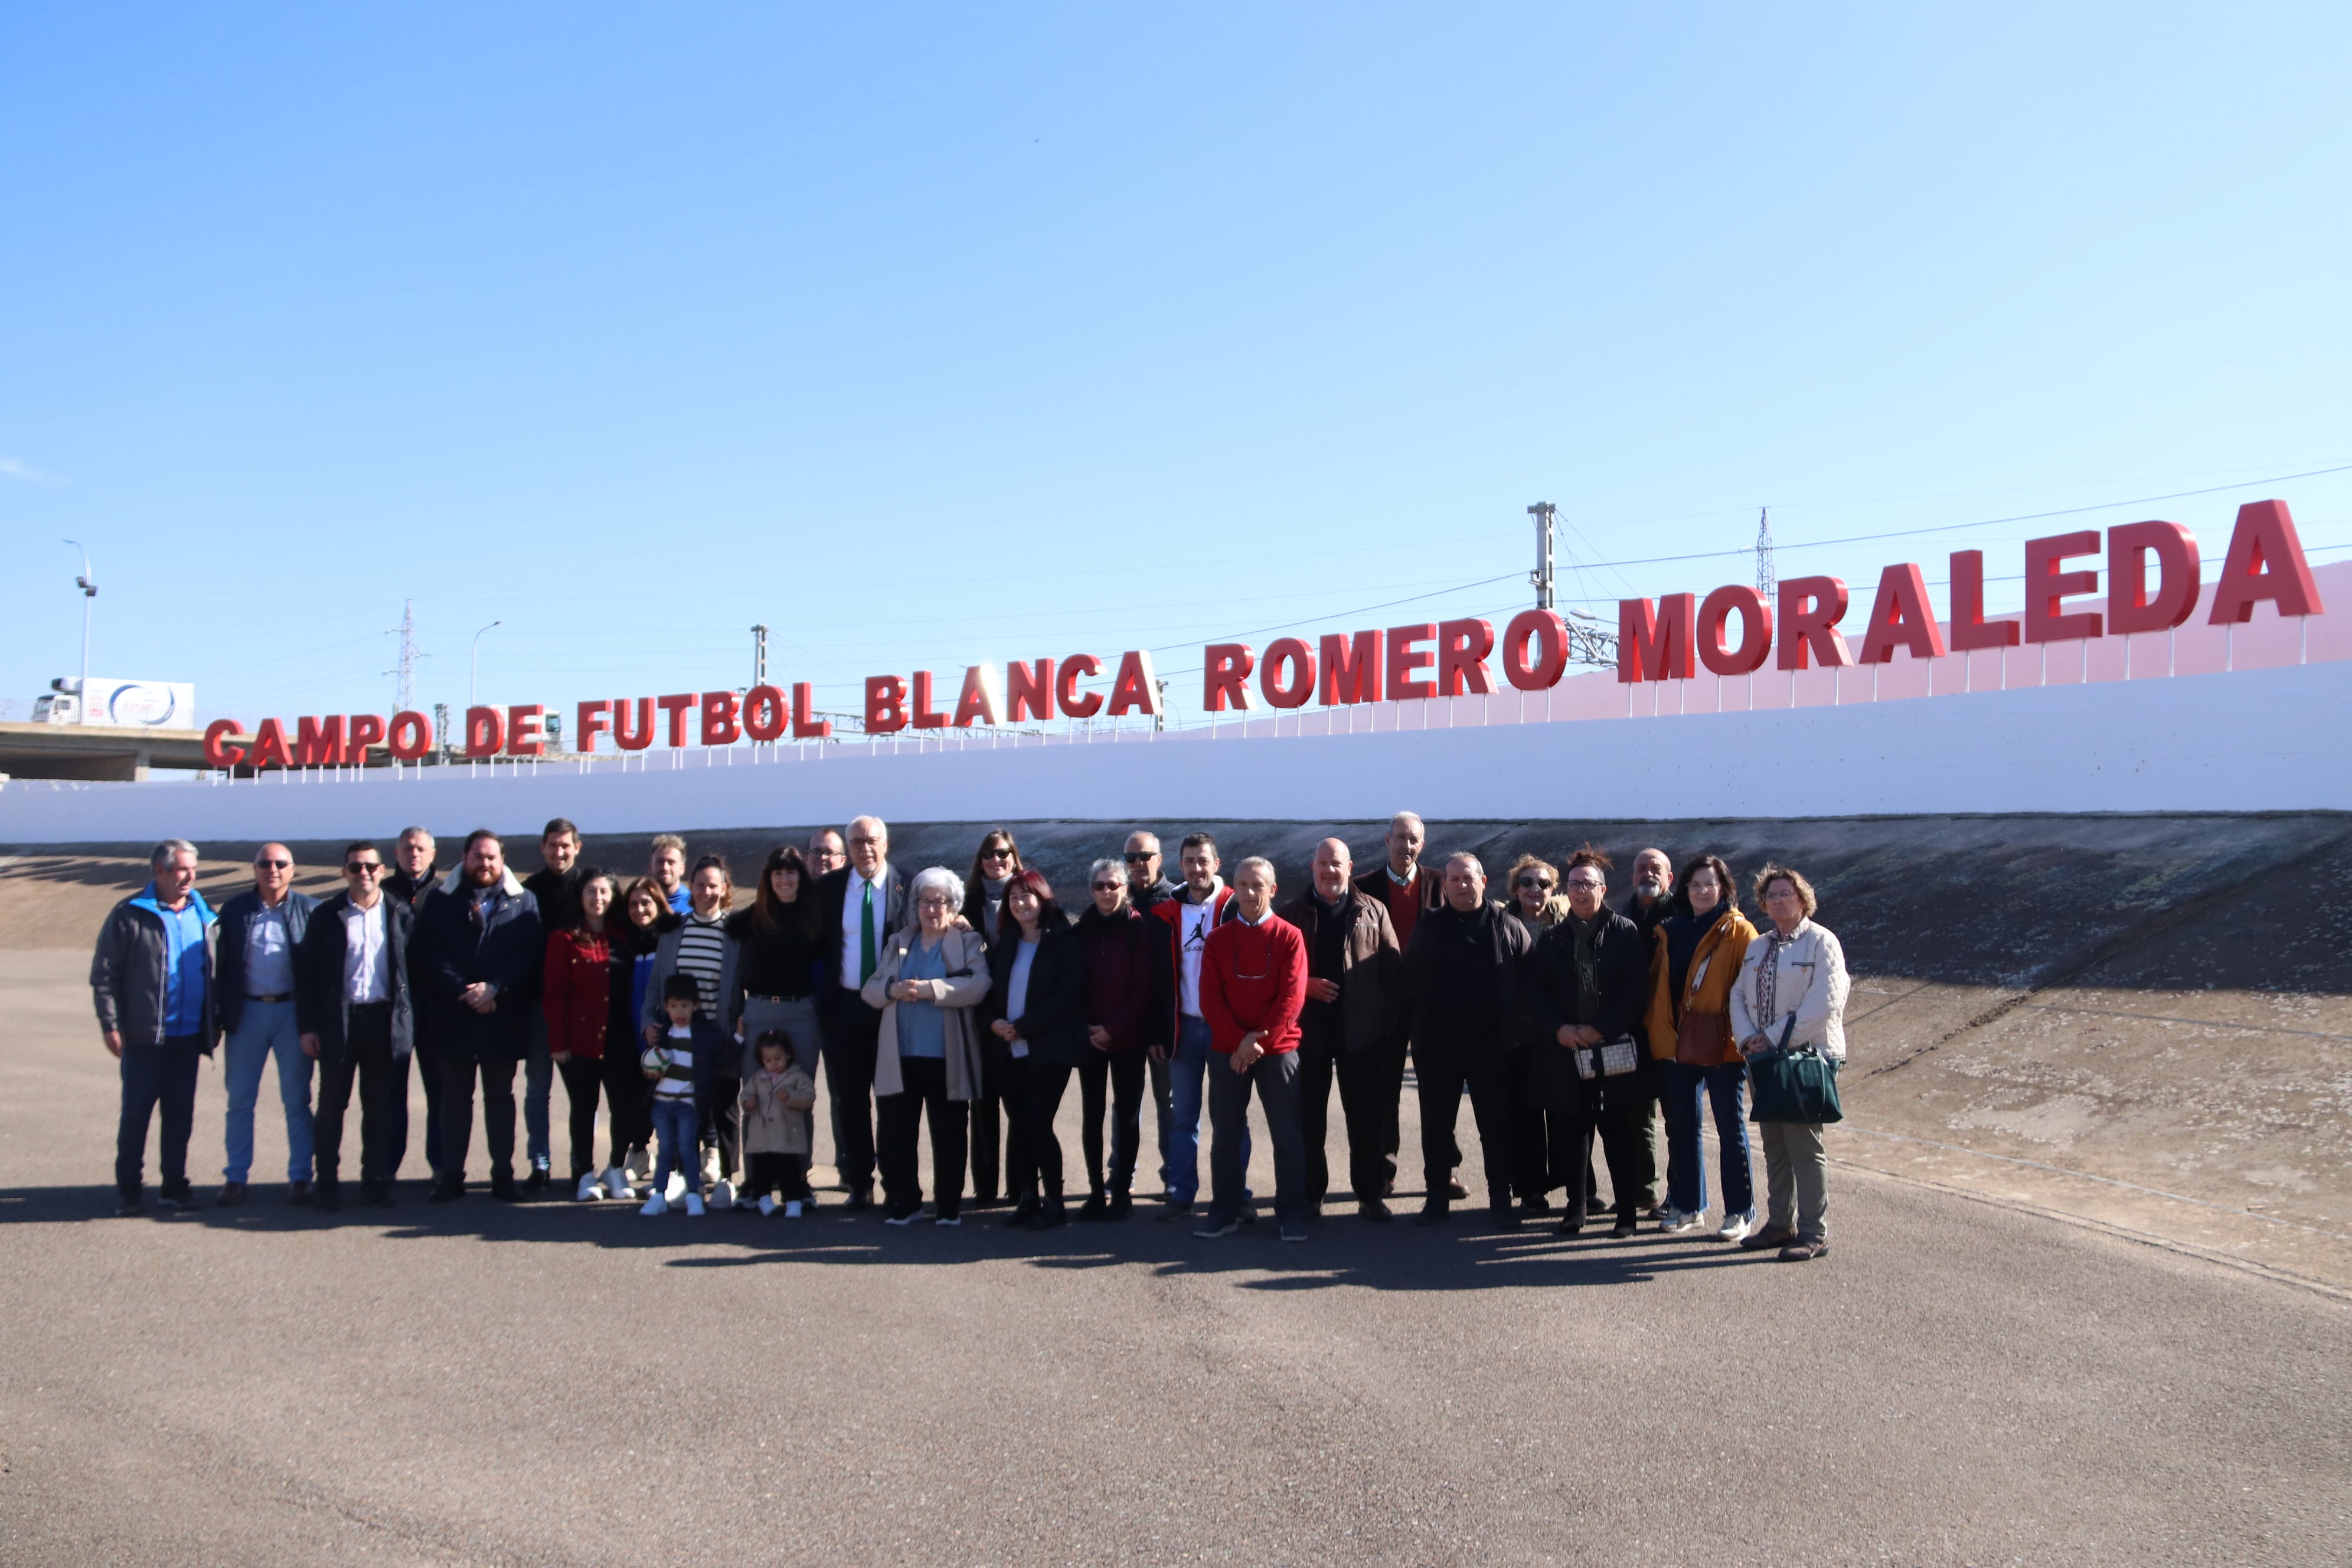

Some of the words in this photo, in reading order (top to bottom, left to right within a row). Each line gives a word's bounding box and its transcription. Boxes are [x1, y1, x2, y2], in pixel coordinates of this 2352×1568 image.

[202, 710, 433, 767] CAMPO
[465, 704, 545, 757] DE
[577, 681, 831, 753] FUTBOL
[864, 650, 1162, 734] BLANCA
[1203, 609, 1568, 712] ROMERO
[1618, 499, 2325, 684] MORALEDA
